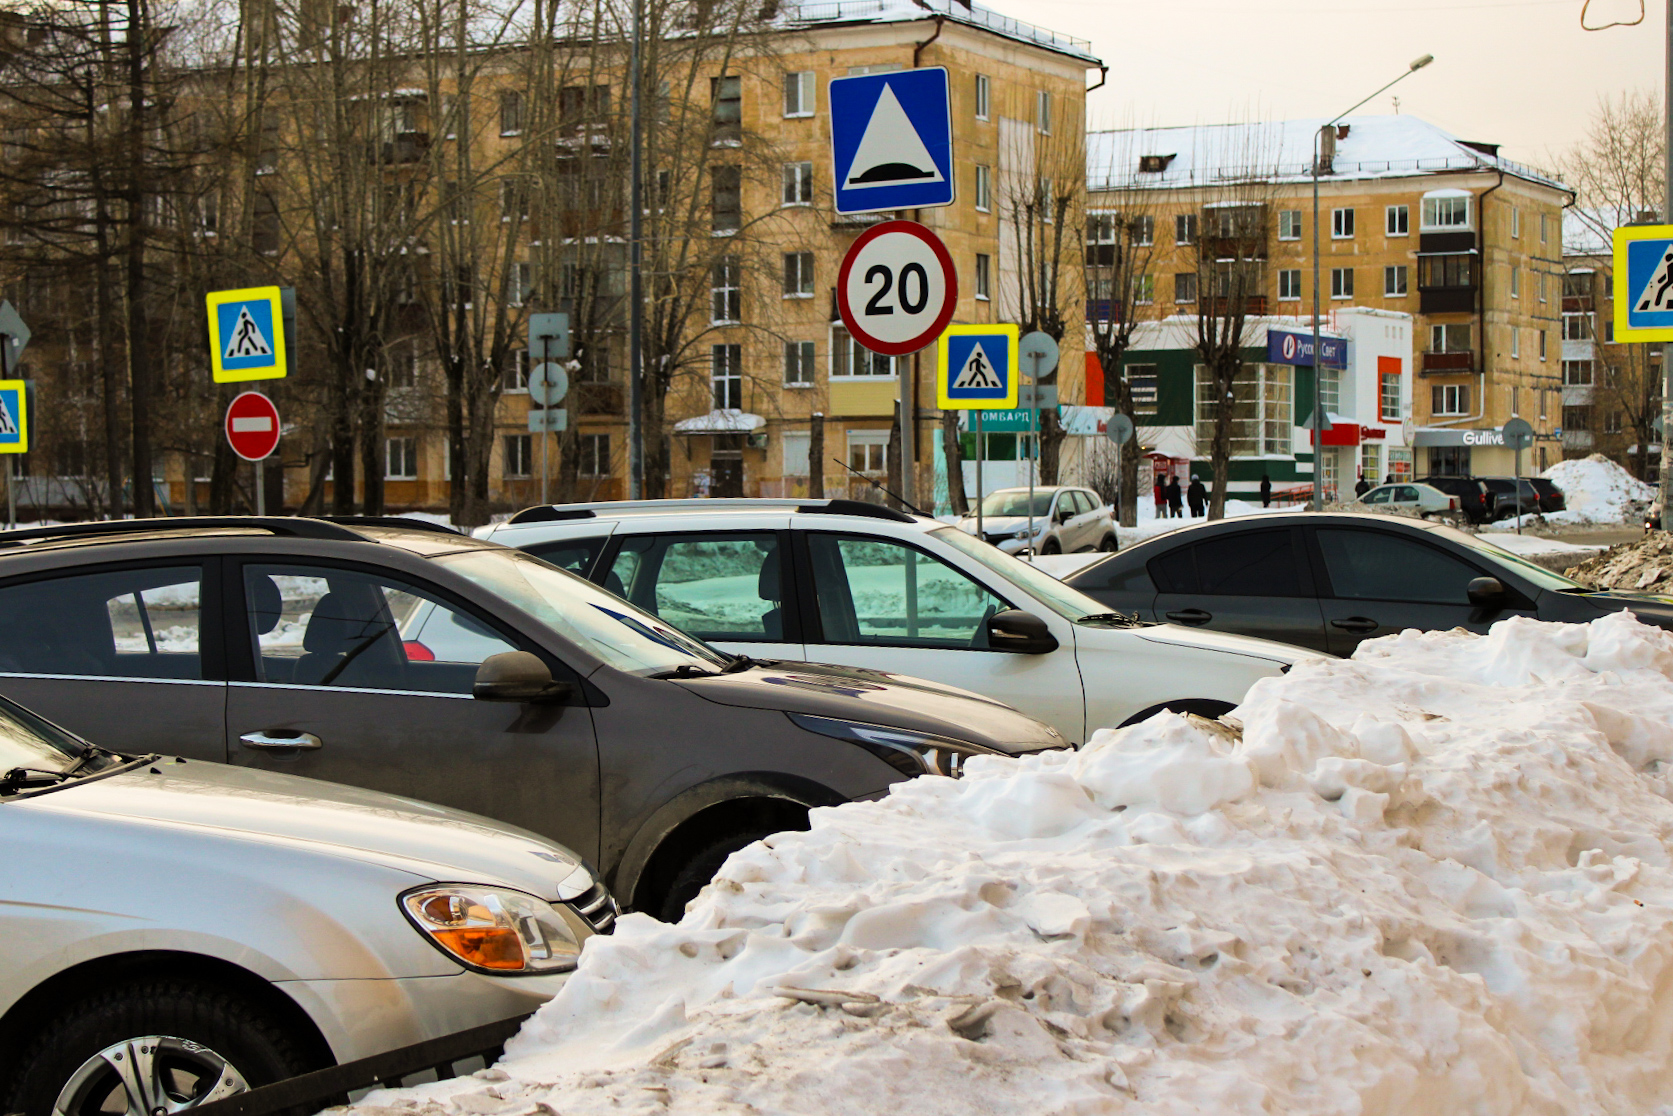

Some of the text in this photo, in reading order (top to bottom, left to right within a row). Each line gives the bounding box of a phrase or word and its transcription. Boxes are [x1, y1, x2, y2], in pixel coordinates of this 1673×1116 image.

[864, 262, 929, 316] 20
[1297, 340, 1336, 358] Русск Свет
[1462, 430, 1505, 446] Gullive
